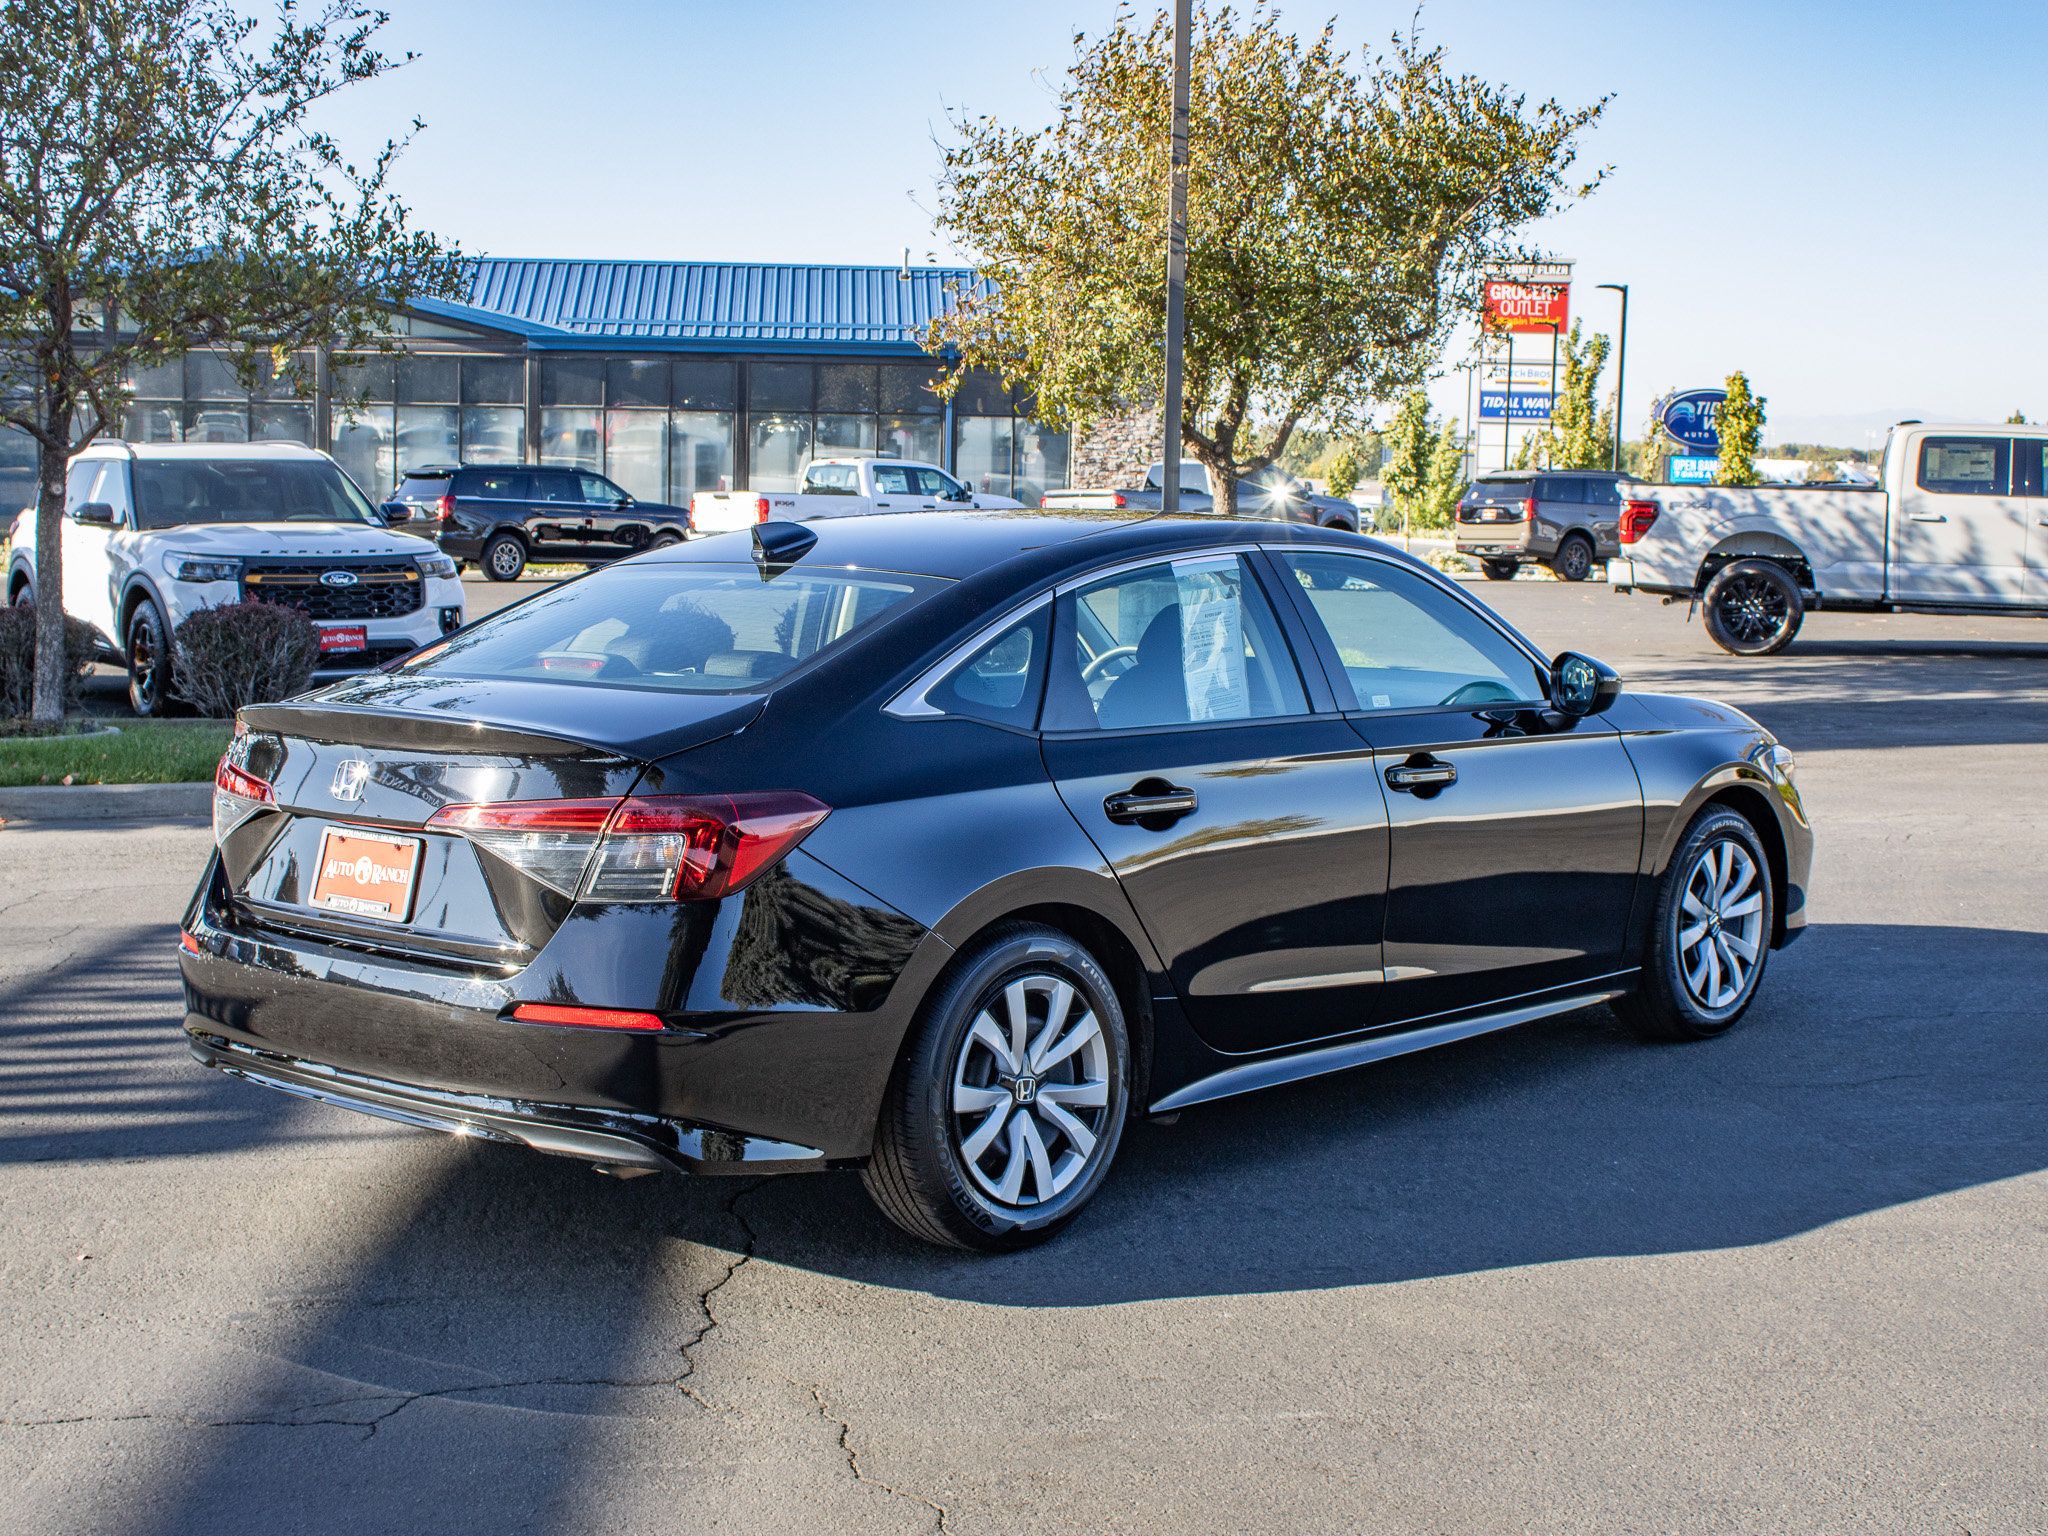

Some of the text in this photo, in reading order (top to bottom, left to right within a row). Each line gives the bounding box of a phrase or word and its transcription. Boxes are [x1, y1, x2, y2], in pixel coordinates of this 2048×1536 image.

[1537, 264, 1569, 275] PLAZA
[1490, 284, 1562, 301] GROCERY
[1500, 300, 1552, 316] OUTLET
[1482, 395, 1520, 409] TIDAL
[1696, 401, 1721, 416] TID
[1684, 431, 1710, 439] AUTO
[1673, 459, 1697, 471] OPEN
[329, 574, 350, 584] Ford
[324, 858, 409, 884] AUTO RANCH
